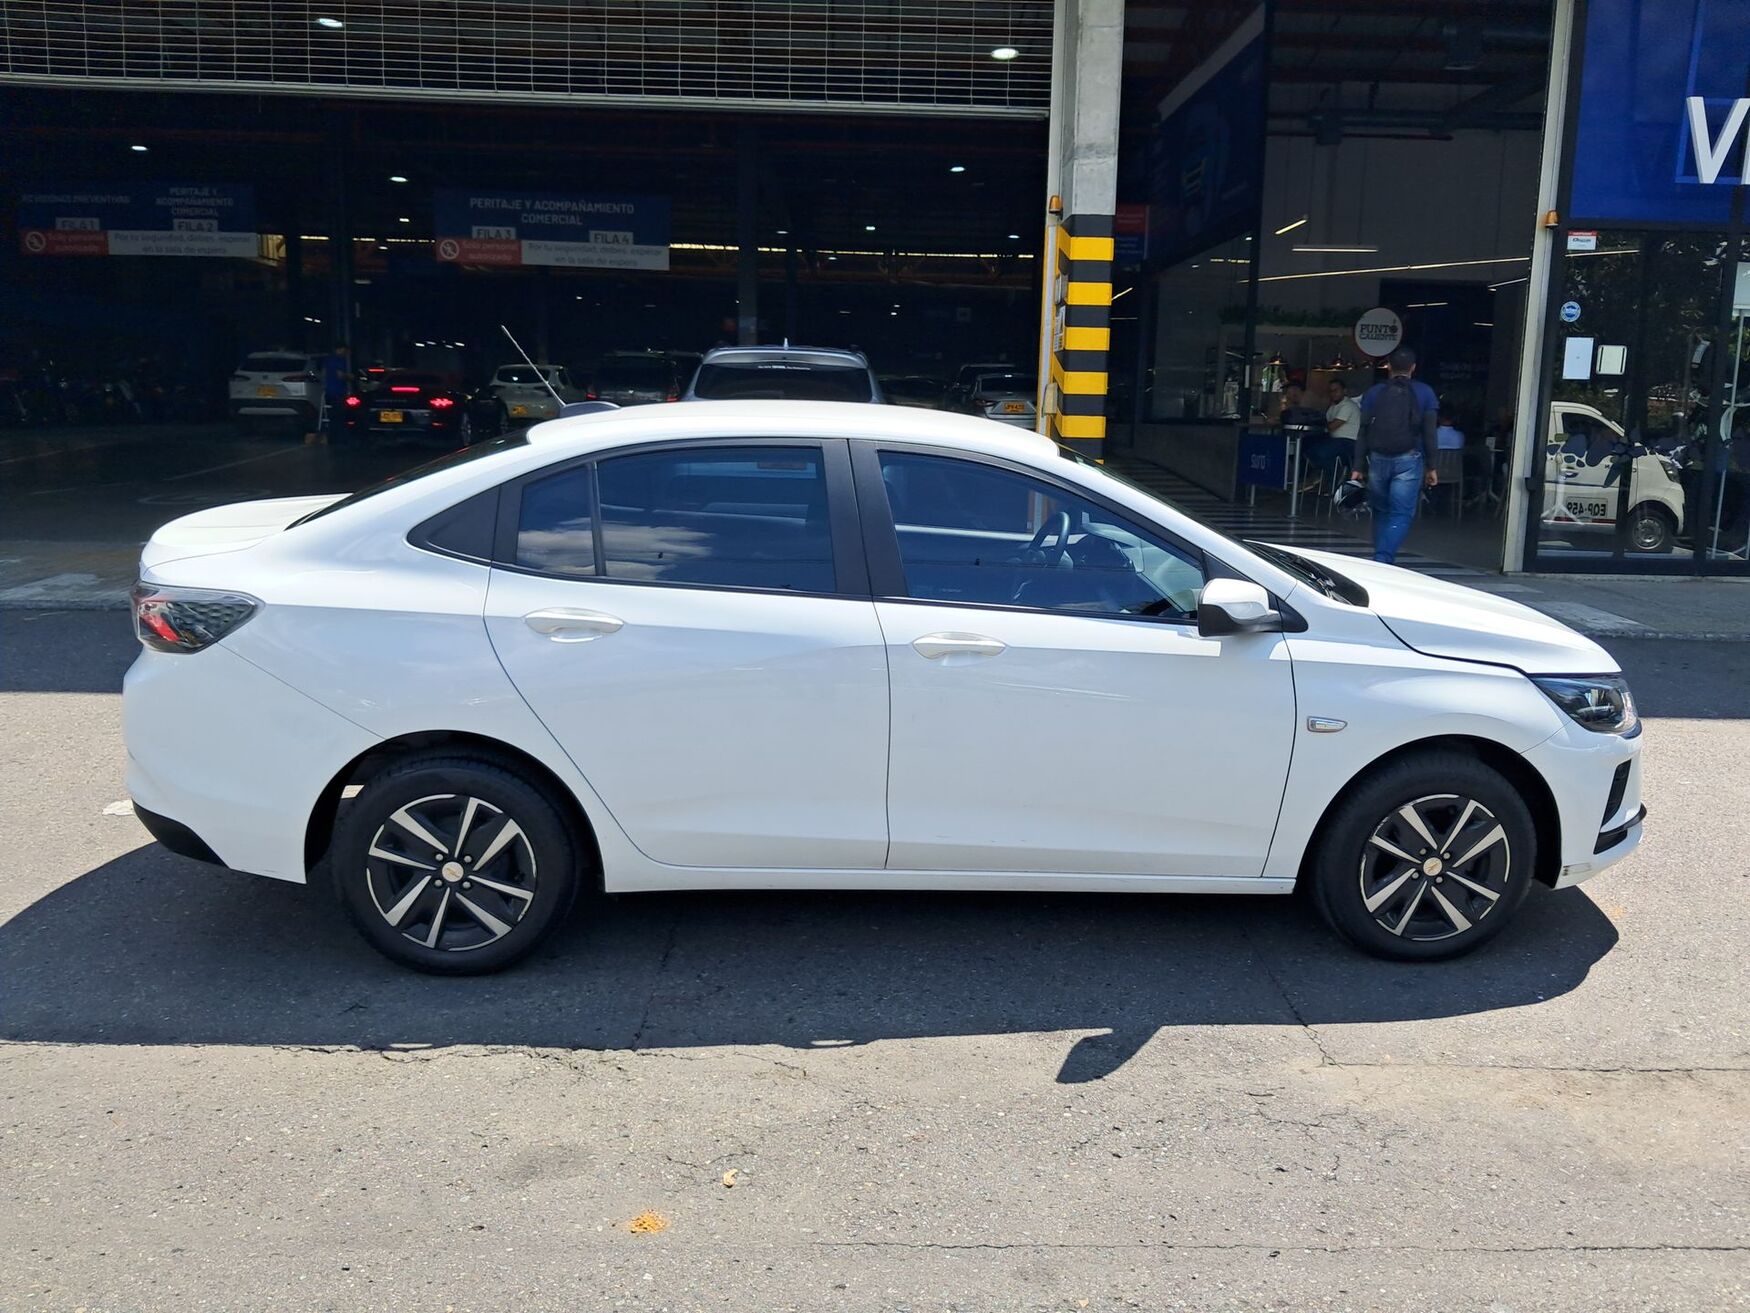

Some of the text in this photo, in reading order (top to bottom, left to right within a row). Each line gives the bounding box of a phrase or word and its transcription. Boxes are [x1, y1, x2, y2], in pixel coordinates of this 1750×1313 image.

[470, 198, 635, 214] PERITAJE Y ACOMPAÑAMIENTO
[521, 213, 583, 226] COMERCIAL
[178, 222, 203, 232] FILA
[476, 229, 501, 239] FILA
[594, 233, 620, 244] FILA
[1360, 322, 1399, 334] PUNTO
